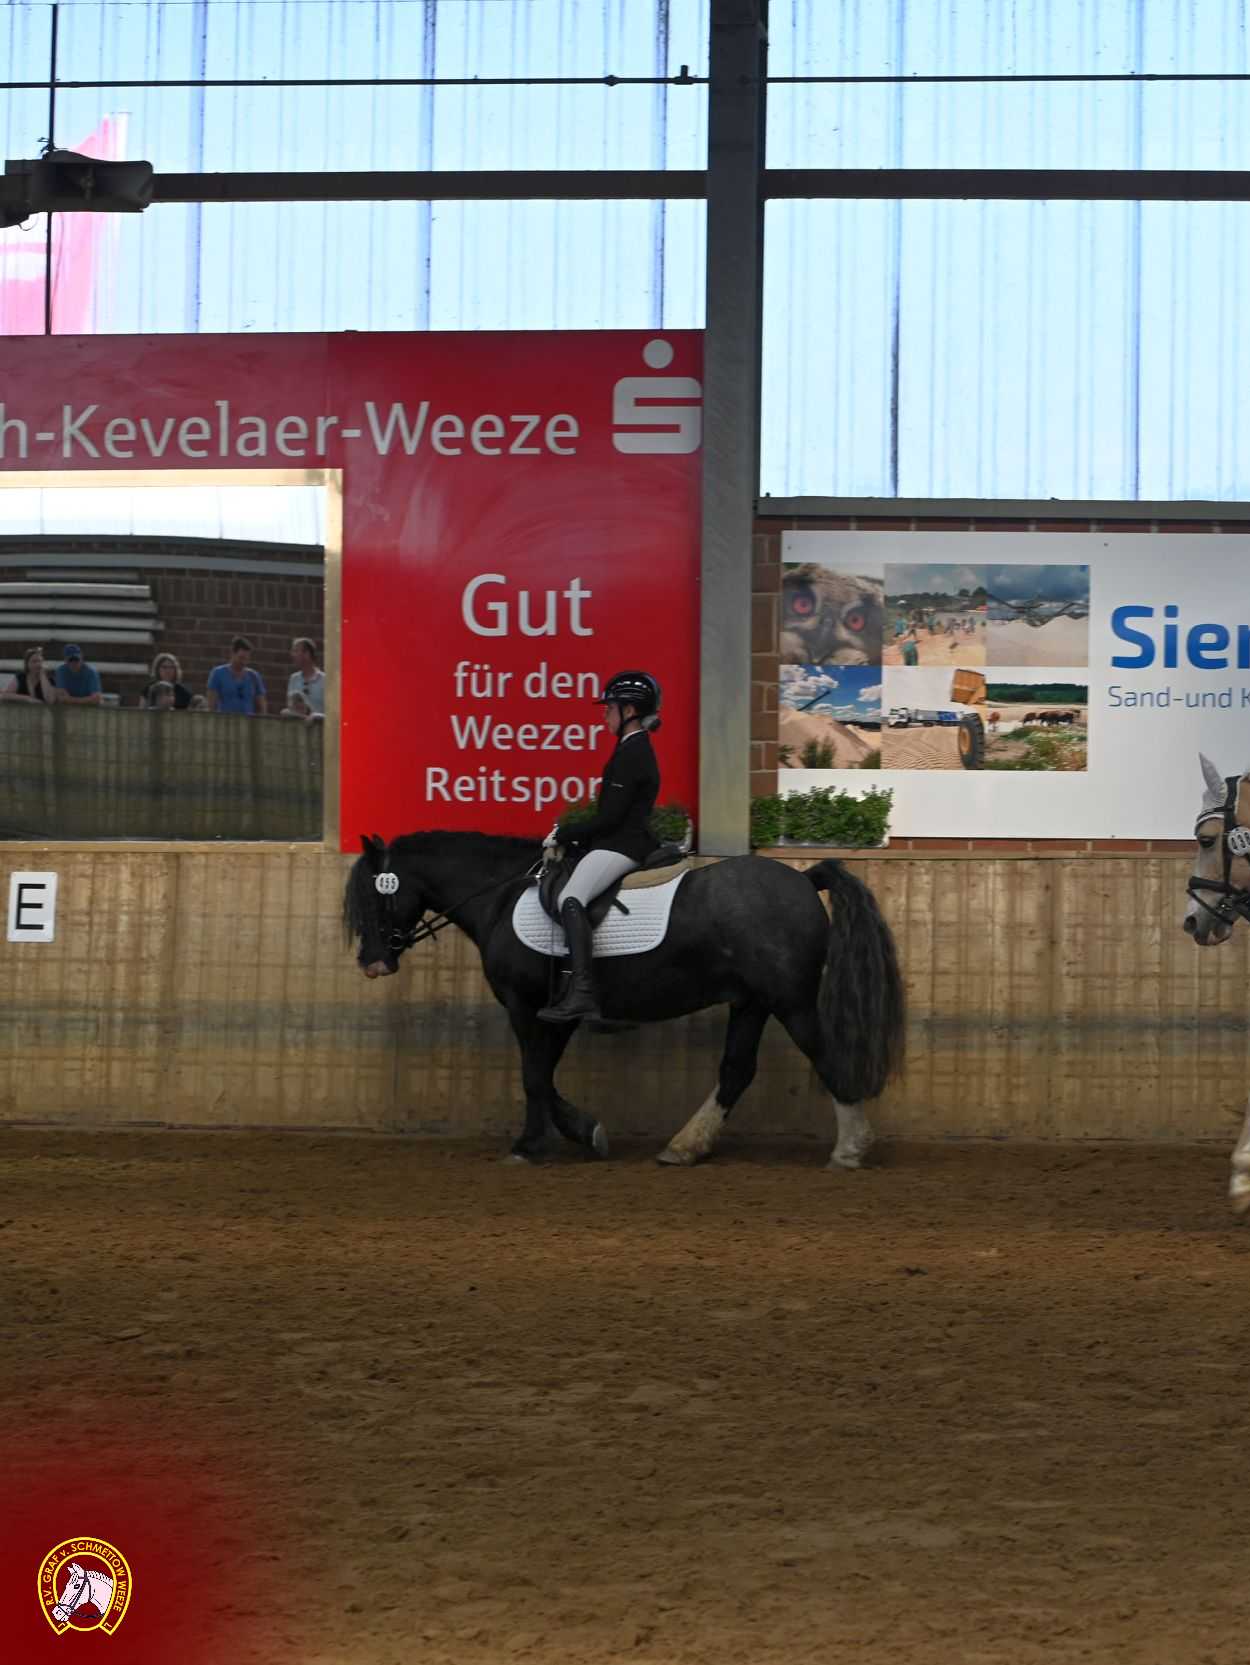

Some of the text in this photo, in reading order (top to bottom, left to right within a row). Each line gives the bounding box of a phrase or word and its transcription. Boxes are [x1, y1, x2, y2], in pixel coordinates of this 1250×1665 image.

[461, 573, 594, 637] Gut
[454, 660, 600, 699] für den
[1108, 685, 1233, 709] Sand-und
[450, 714, 605, 751] Weezer
[425, 766, 603, 812] Reitspor
[15, 883, 46, 930] E
